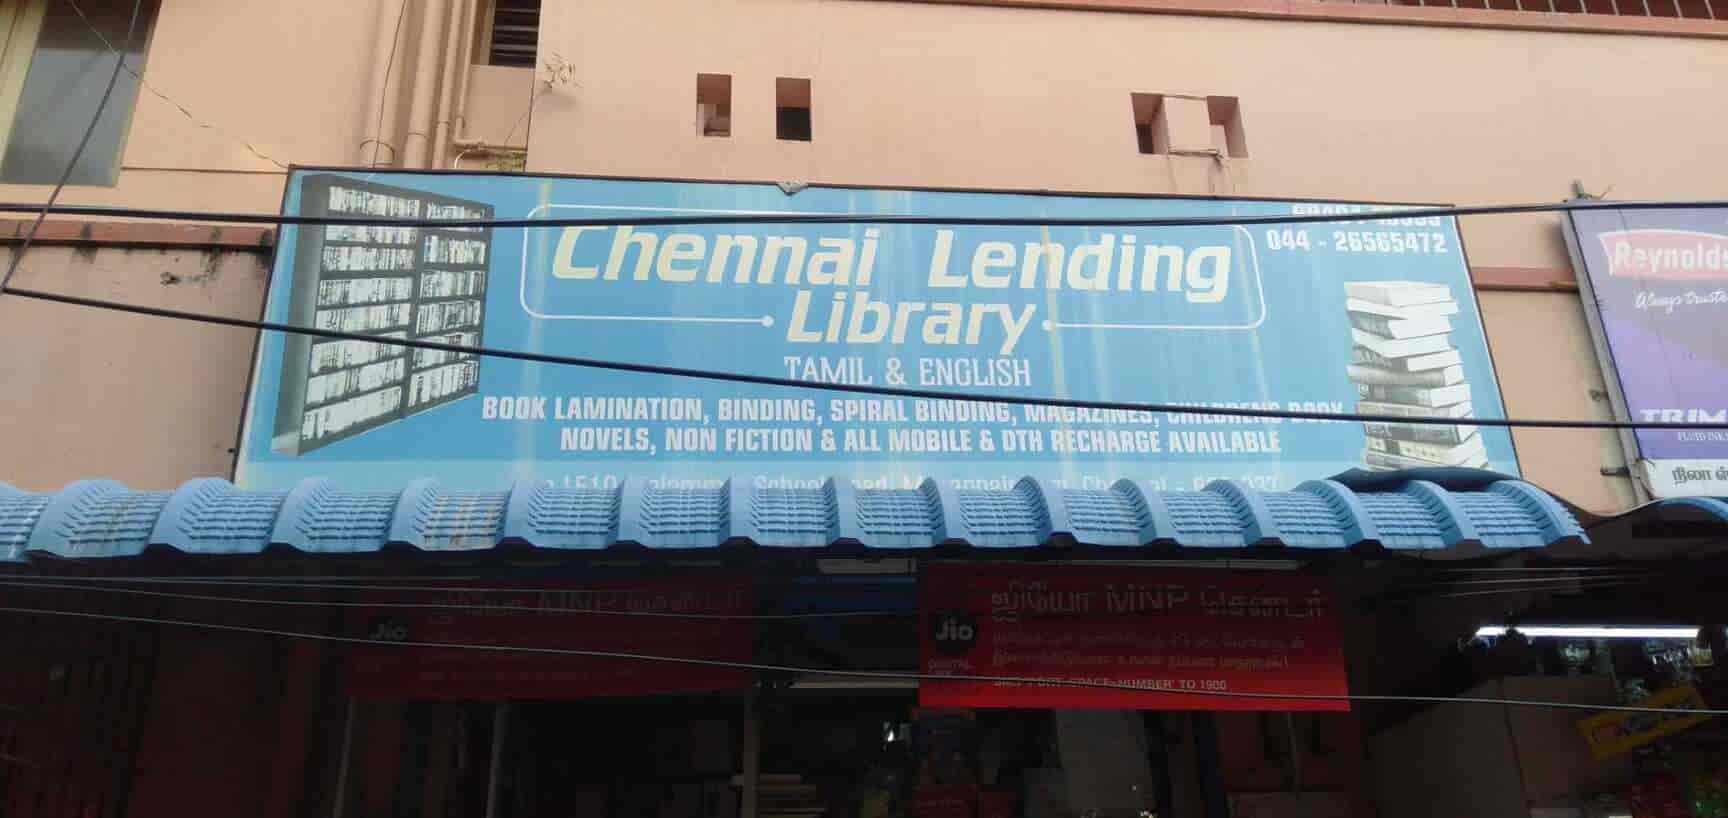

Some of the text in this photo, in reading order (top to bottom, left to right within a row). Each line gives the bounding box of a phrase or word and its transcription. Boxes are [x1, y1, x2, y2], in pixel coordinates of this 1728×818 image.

[1266, 228, 1310, 250] 044
[1333, 231, 1448, 252] 26565472
[551, 223, 1232, 303] Chennai Lending
[785, 289, 1037, 355] Library
[784, 356, 1032, 386] TAMIL & ENGLISH
[481, 397, 547, 420] BOOK
[554, 397, 710, 425] LAMINATION,
[718, 398, 823, 425] BINDING,
[831, 399, 908, 421] SPIRAL
[915, 399, 1017, 426] BINDING,
[1023, 401, 1160, 427] MAGAZINES,
[560, 427, 1282, 455] NOVELS, NON FICTION & ALL MOBILE & DTH RECHARGE AVAILABLE
[1103, 583, 1191, 617] MNP
[935, 617, 975, 641] Jio
